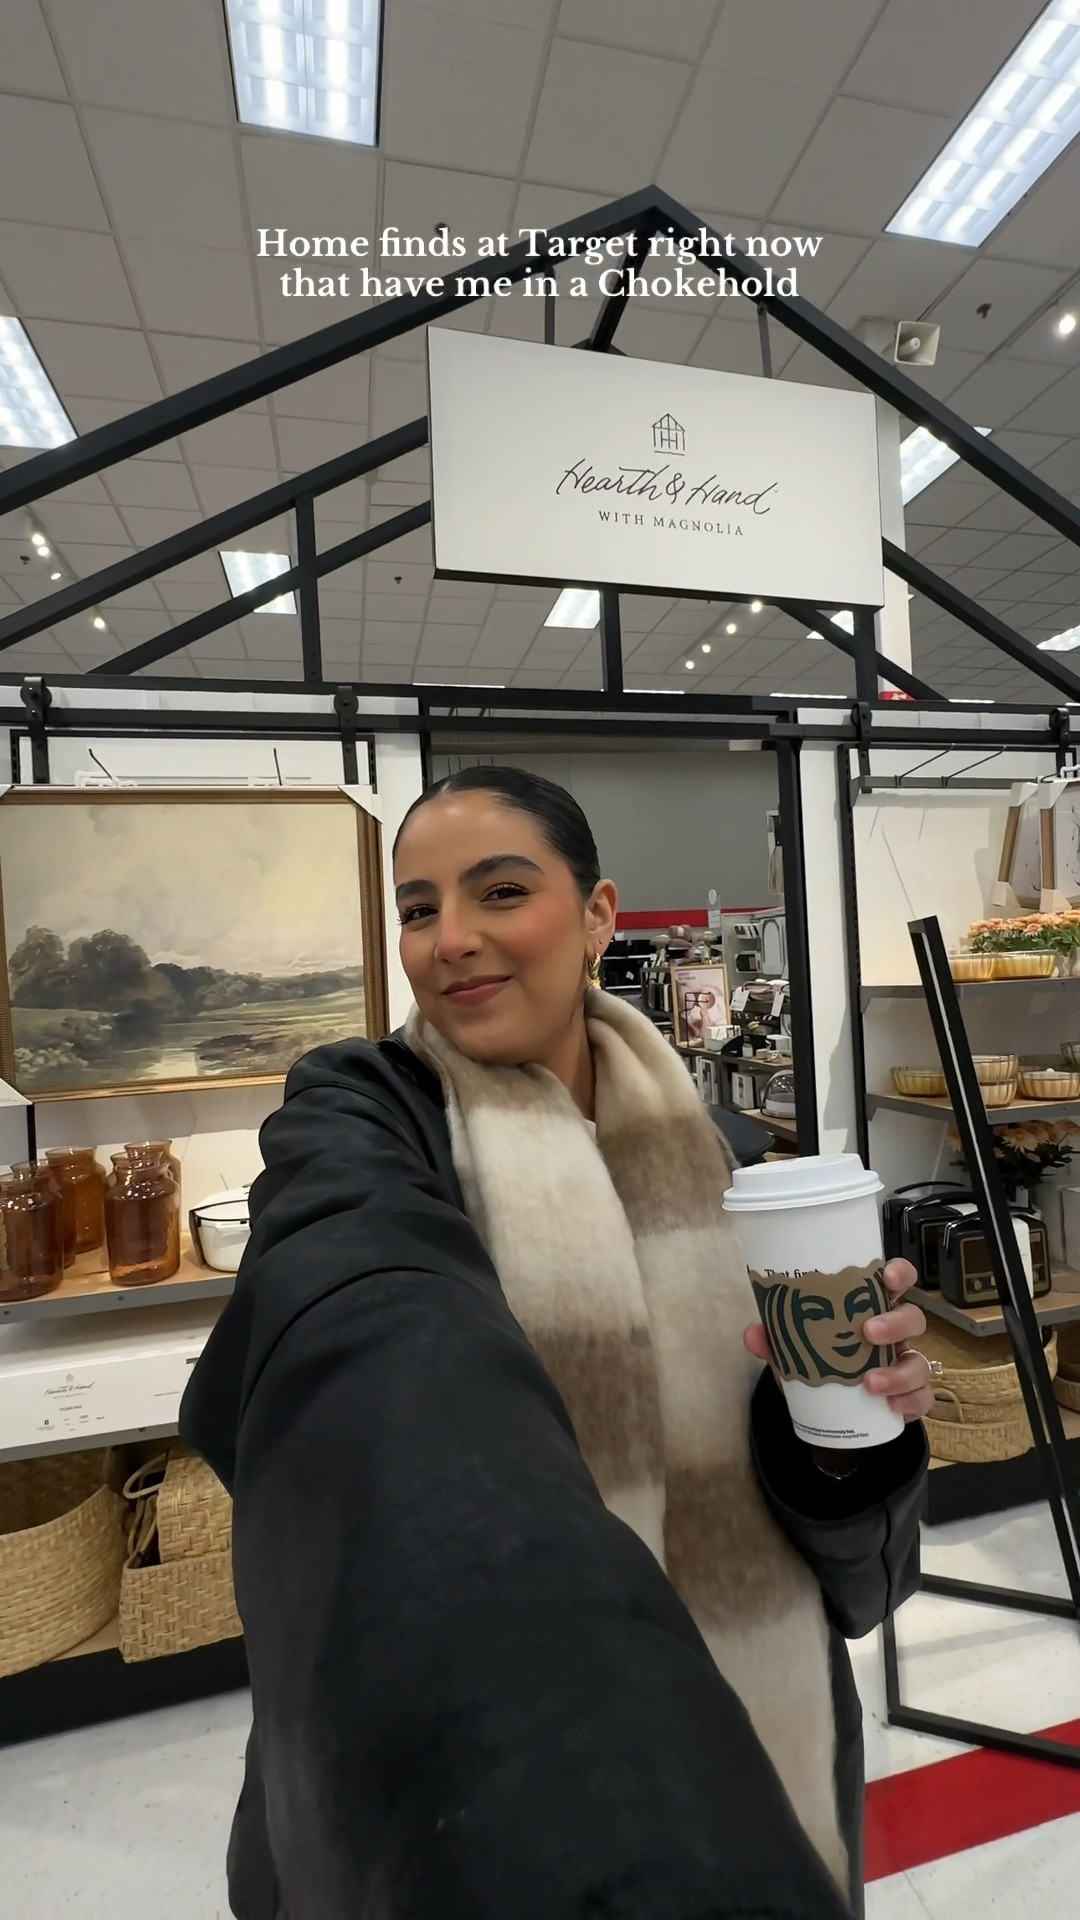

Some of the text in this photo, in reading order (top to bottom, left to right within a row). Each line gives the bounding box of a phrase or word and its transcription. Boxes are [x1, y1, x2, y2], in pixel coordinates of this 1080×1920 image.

[555, 458, 778, 515] Hearth & Hand
[598, 510, 744, 536] WITH MAGNOLIA
